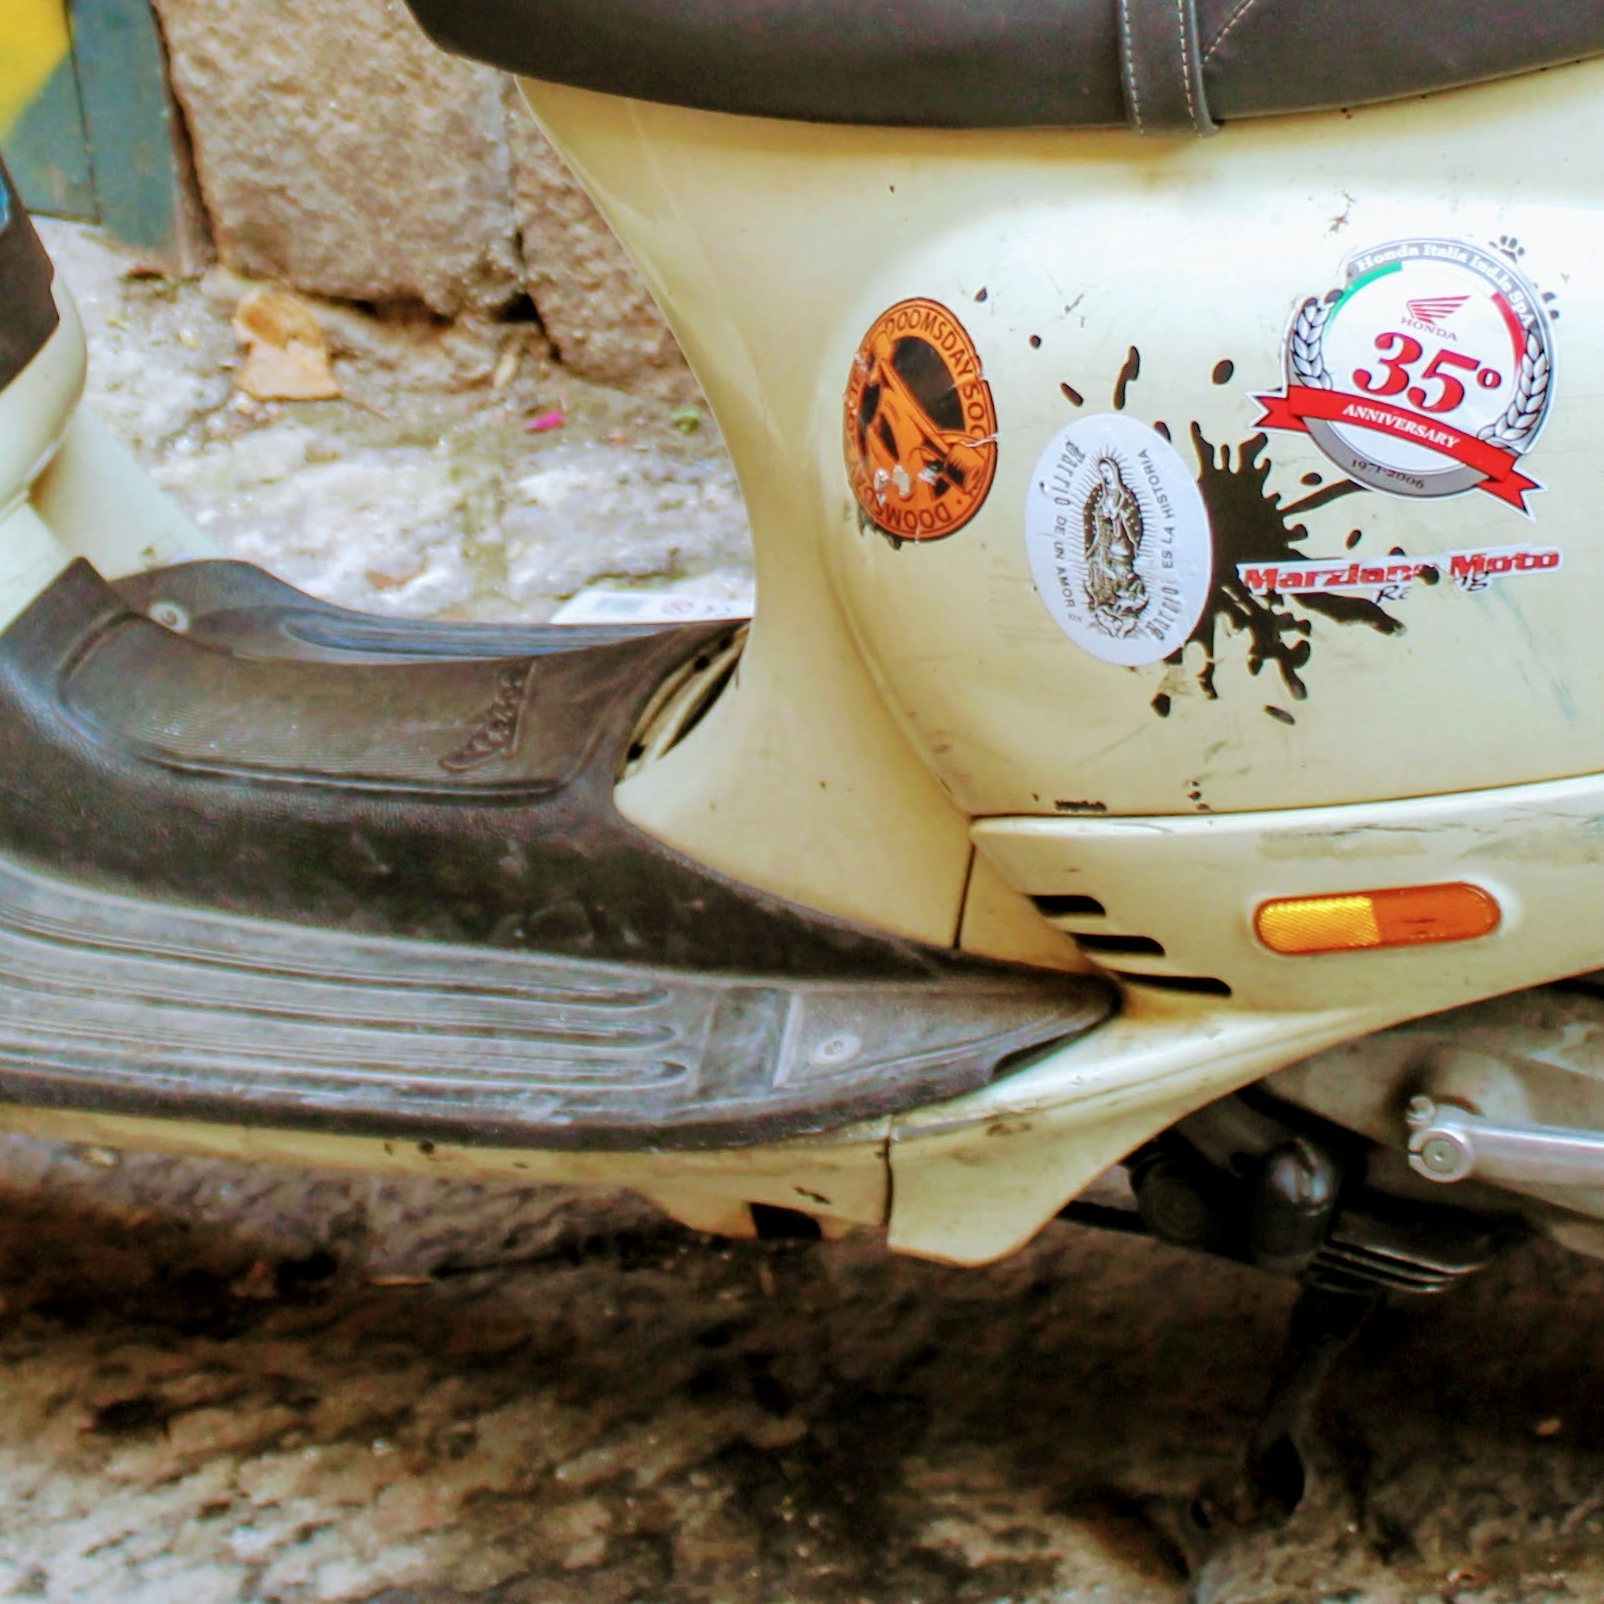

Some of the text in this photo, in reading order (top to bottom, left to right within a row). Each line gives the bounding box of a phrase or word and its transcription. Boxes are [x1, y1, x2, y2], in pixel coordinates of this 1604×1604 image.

[1355, 244, 1420, 272] Honda
[1424, 244, 1470, 266] Italia
[1400, 315, 1459, 342] HONDA
[1342, 404, 1461, 449] ANNIVERSARY
[1137, 449, 1175, 519] HISTORIA
[1350, 459, 1425, 489] 1971-2006
[1054, 516, 1067, 535] DE
[1162, 527, 1175, 544] LA
[1053, 541, 1065, 560] UN
[1162, 551, 1174, 569] ES
[1449, 550, 1560, 578] Moto
[1055, 567, 1076, 609] AMOR
